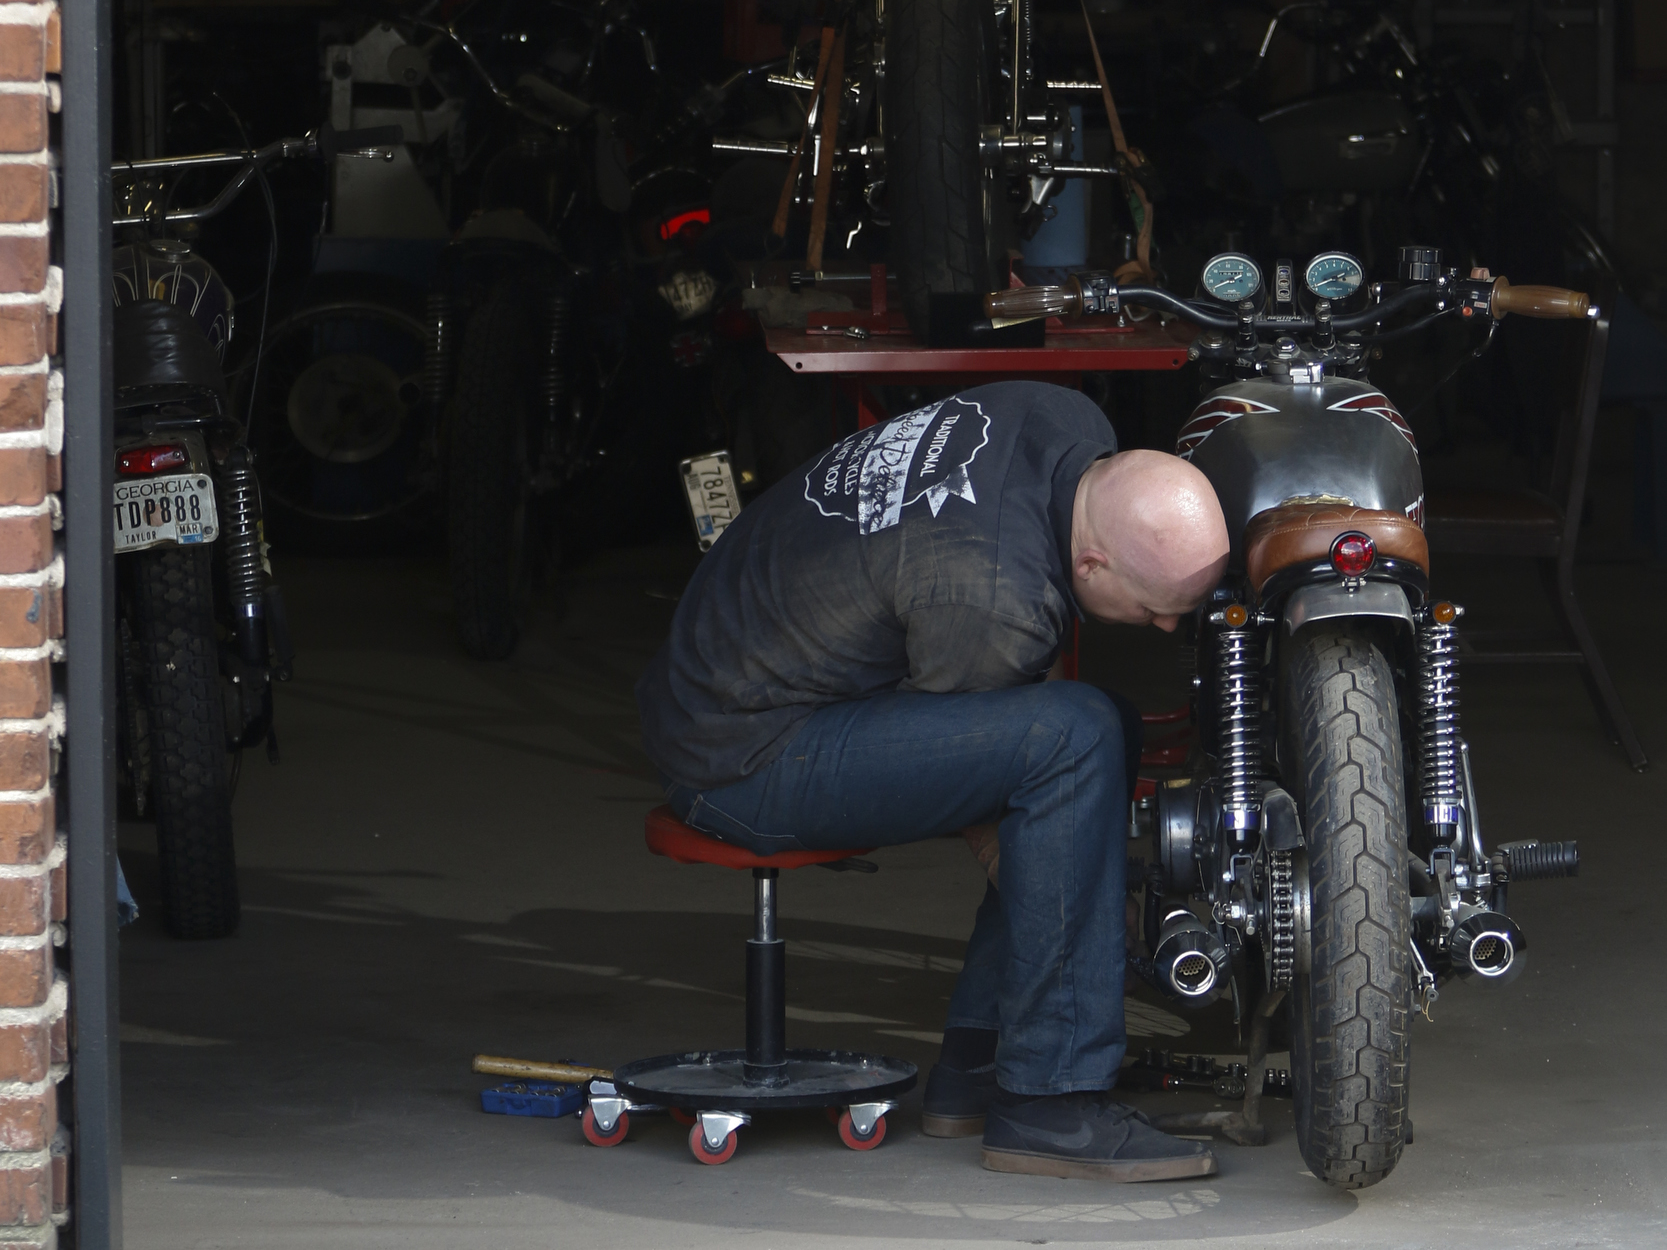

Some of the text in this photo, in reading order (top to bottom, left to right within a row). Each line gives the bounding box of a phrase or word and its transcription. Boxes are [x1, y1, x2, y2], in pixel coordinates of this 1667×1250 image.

[919, 413, 961, 478] TRADITIONAL
[823, 463, 842, 497] RODS
[844, 430, 877, 496] MOTORCYCLES
[116, 479, 195, 500] GEORGIA
[114, 494, 201, 531] TDP888
[179, 524, 198, 535] MAR
[125, 530, 157, 544] TAYLOR
